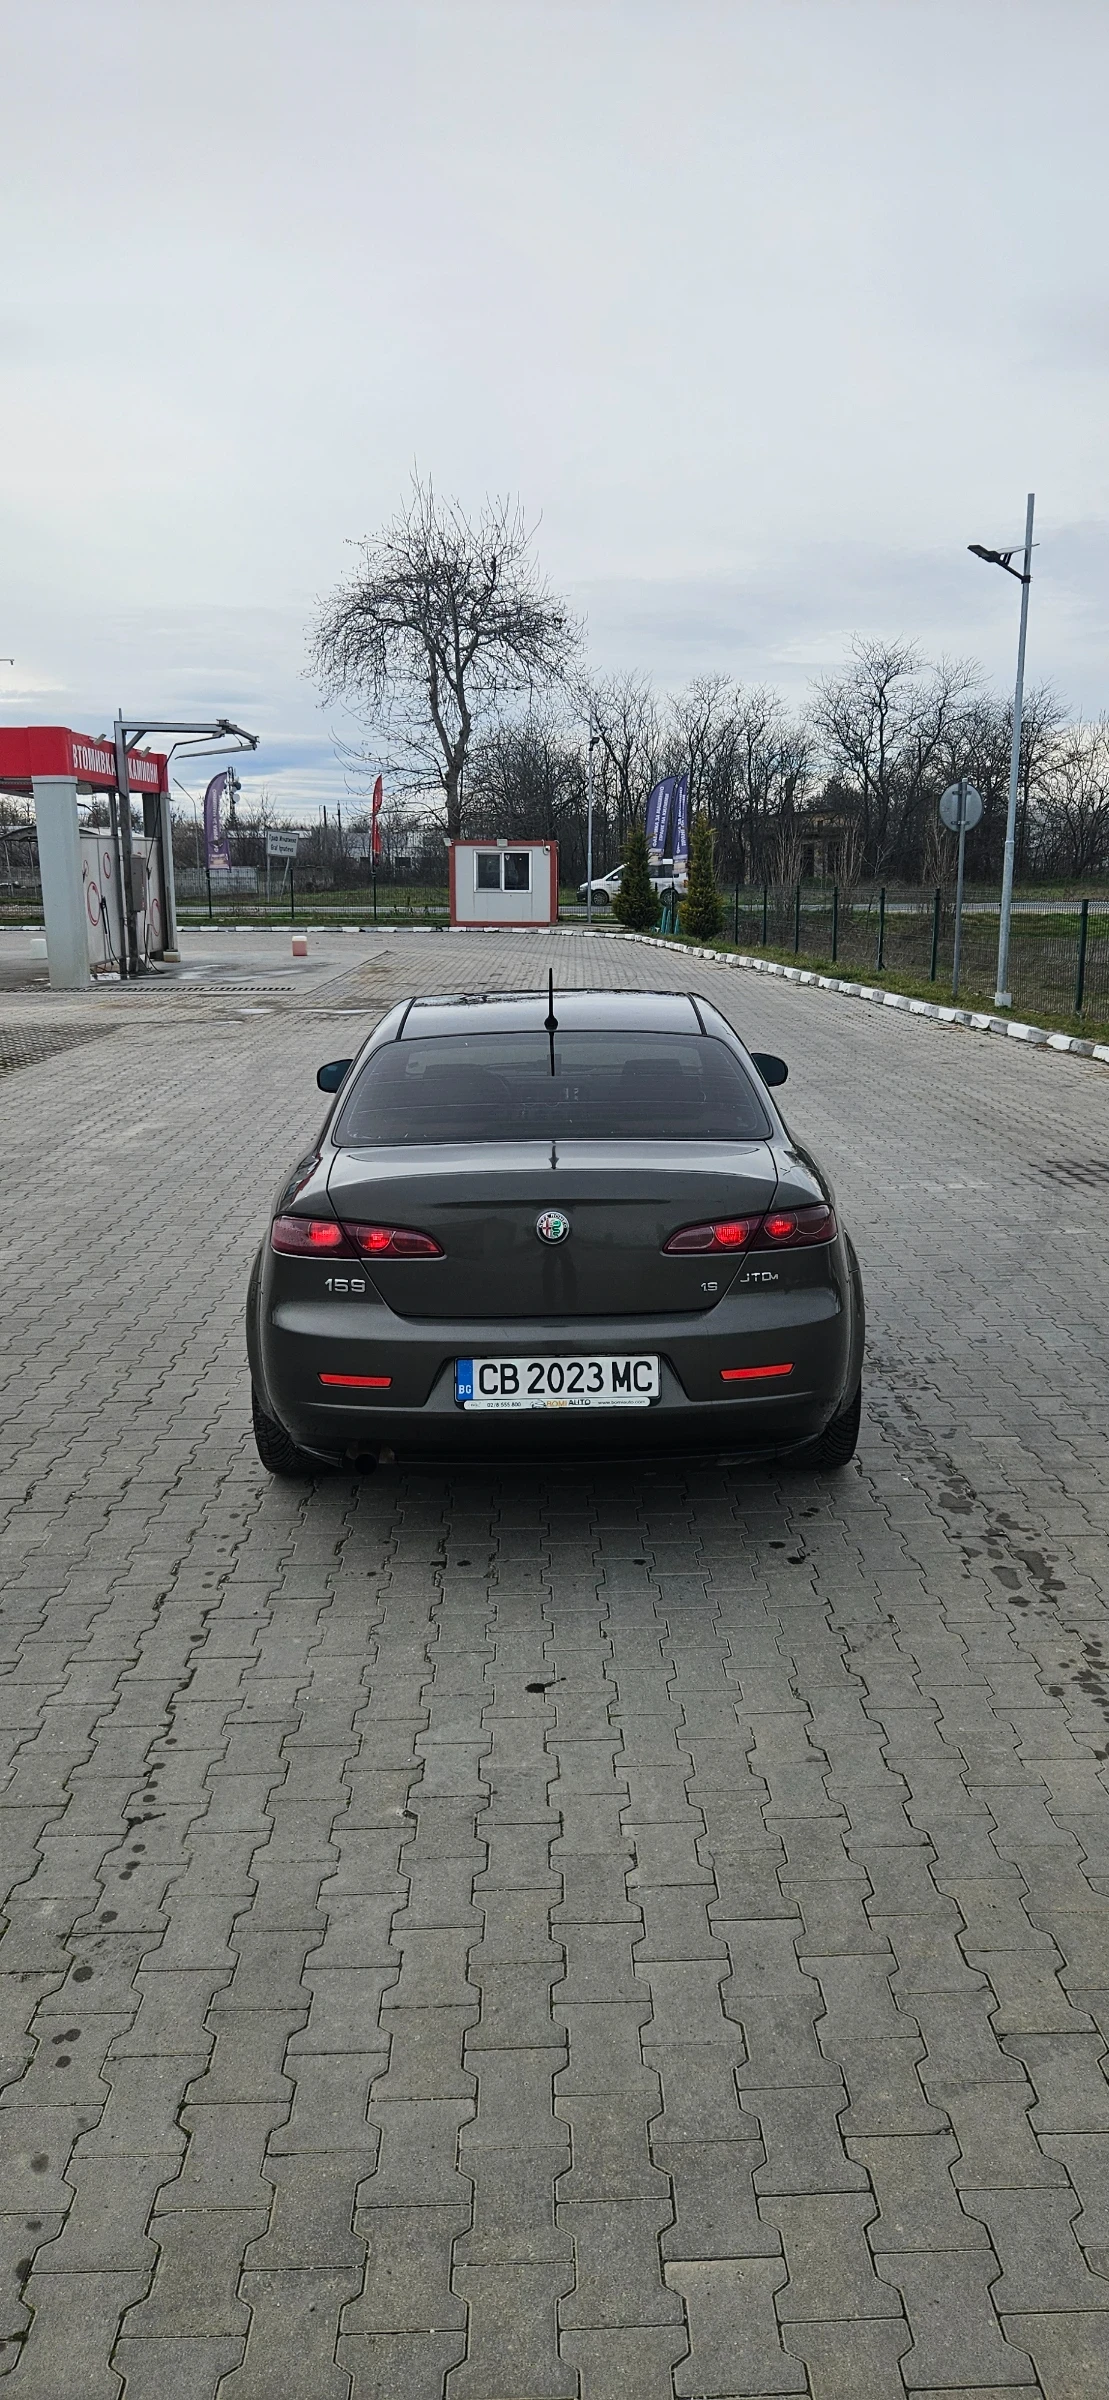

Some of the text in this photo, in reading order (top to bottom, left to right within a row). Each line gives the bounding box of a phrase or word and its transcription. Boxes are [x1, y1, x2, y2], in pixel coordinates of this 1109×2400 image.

[127, 757, 159, 784] КАМИОНИ
[325, 1278, 366, 1293] 159
[478, 1361, 652, 1395] CB 2023 MC
[458, 1384, 472, 1394] BG
